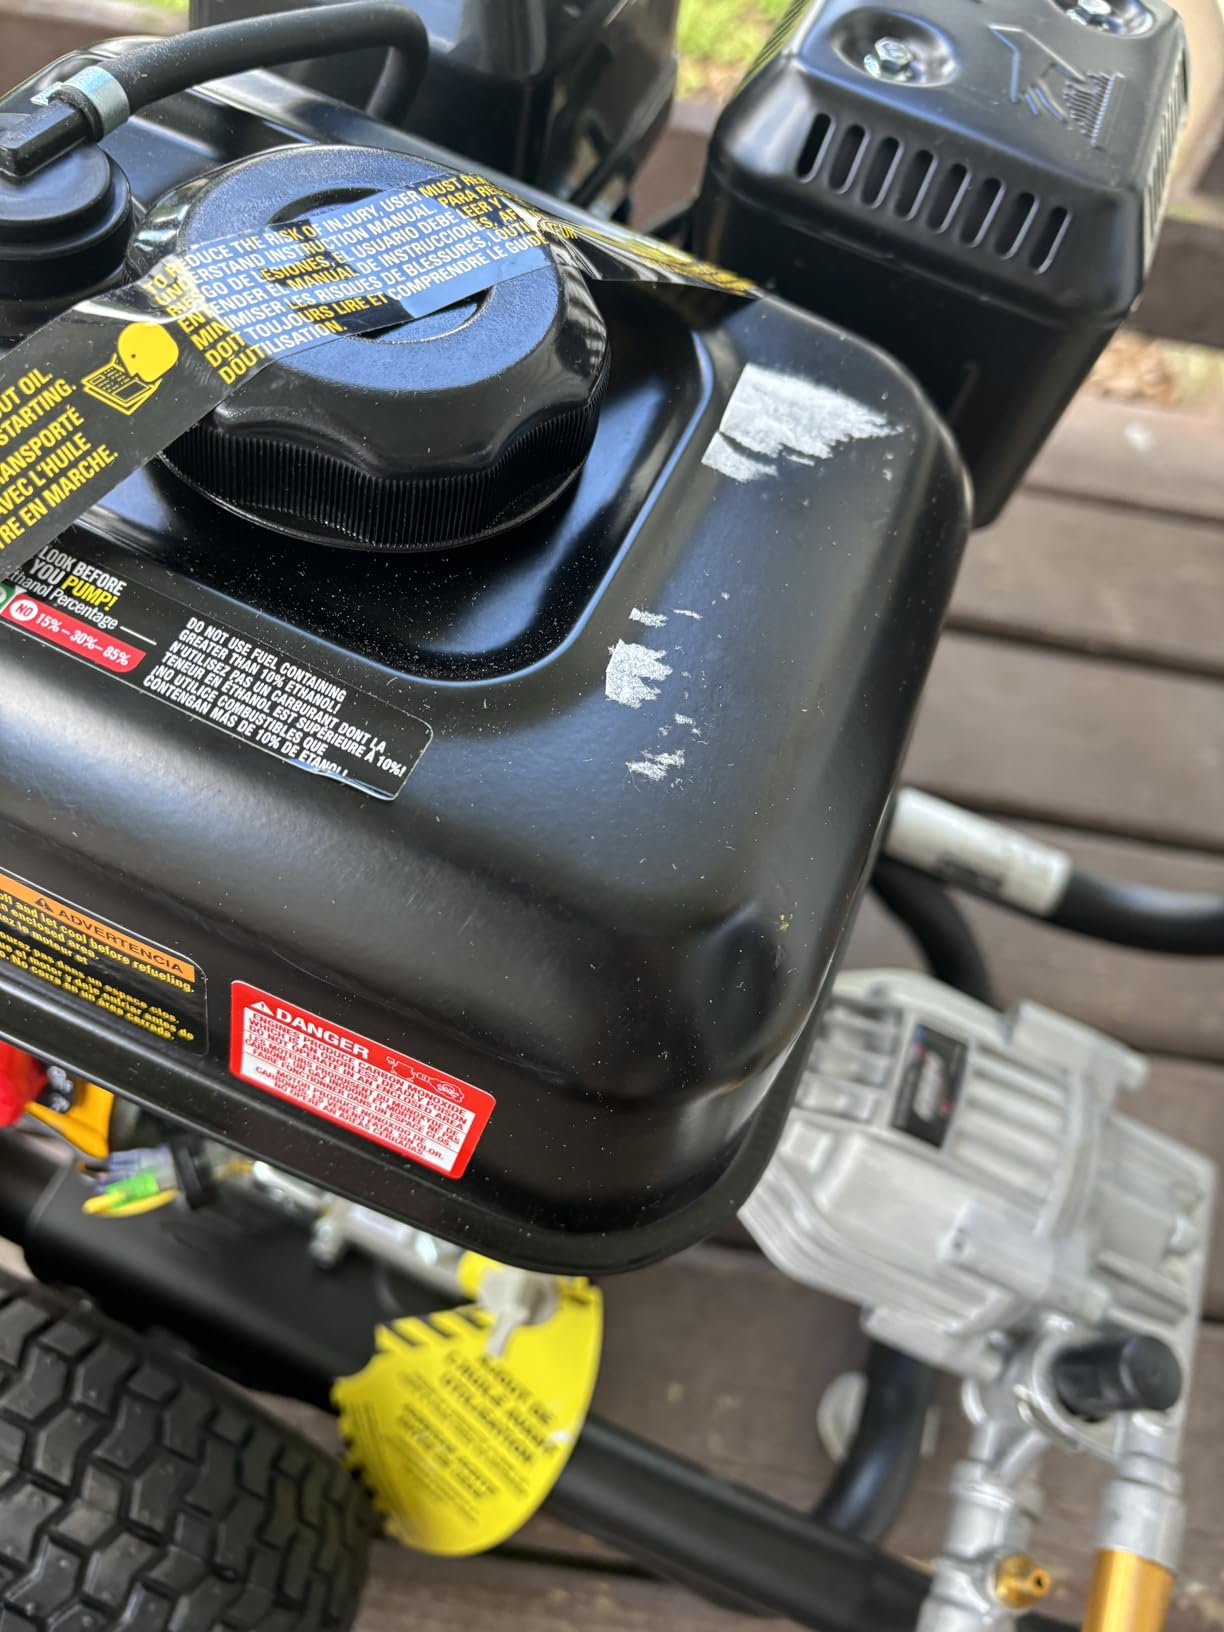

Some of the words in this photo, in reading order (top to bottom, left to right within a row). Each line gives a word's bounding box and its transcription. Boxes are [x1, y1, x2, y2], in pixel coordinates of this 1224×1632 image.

[155, 251, 264, 306] UNDERSTAND
[263, 223, 370, 264] INSTRUCTION
[369, 204, 438, 238] MANUAL.
[438, 190, 478, 210] PARA
[231, 233, 266, 257] THE
[263, 227, 304, 247] RISK
[302, 222, 322, 239] OF
[323, 205, 384, 233] INJURY,
[380, 190, 423, 215] USER
[418, 177, 458, 199] MUST
[231, 272, 255, 291] DE
[253, 255, 336, 285] LESIONES,
[333, 247, 355, 266] EL
[351, 223, 421, 261] USUARIO
[417, 213, 460, 239] DEBE
[458, 199, 493, 221] LEER
[489, 195, 503, 211] Y
[176, 287, 269, 333] ENTENDER
[267, 282, 290, 300] EL
[285, 263, 359, 292] MANUAL
[356, 256, 381, 276] DE
[379, 214, 496, 268] INSTRUCCIONES.
[188, 299, 286, 352] MINIMISER
[286, 291, 316, 311] LES
[314, 275, 382, 305] RISQUES
[380, 266, 407, 288] DE
[404, 234, 492, 277] BLESSURES,
[203, 332, 248, 368] DOIT
[244, 304, 335, 341] TOUJOURS
[332, 296, 371, 316] LIRE
[367, 291, 389, 307] ET
[386, 254, 490, 301] COMPRENDRE
[486, 246, 508, 264] LE
[504, 234, 550, 256] GUIDE
[17, 367, 53, 395] OIL.
[18, 498, 49, 528] EN
[41, 444, 119, 508] MARCHE.
[30, 431, 92, 487] L'HUILE
[10, 568, 52, 596] thanol
[49, 589, 119, 631] Percentage
[29, 559, 64, 586] YOU
[61, 575, 117, 612] PUMP!
[39, 545, 75, 571] LOOK
[73, 561, 126, 595] BEFORE
[15, 603, 33, 618] NO
[36, 613, 61, 632] 15%
[169, 641, 230, 676] N'UTILISEZ
[230, 670, 254, 688] PAS
[253, 681, 271, 696] UN
[270, 690, 338, 729] CARBURANT
[338, 723, 370, 744] DONT
[370, 738, 387, 753] LA
[178, 629, 229, 660] GREATER
[229, 653, 260, 674] THAN
[259, 668, 286, 687] 10%
[285, 681, 341, 714] ETHANOL!
[186, 618, 205, 633] DO
[204, 626, 228, 644] NOT
[227, 637, 252, 656] USE
[250, 648, 281, 669] FUEL
[279, 662, 348, 702] CONTAINING
[143, 675, 211, 714] CONTENGAN
[209, 706, 239, 727] MÁS
[237, 720, 256, 736] DE
[254, 729, 282, 749] 10%
[280, 741, 300, 757] DE
[161, 652, 205, 679] TENEUR
[204, 673, 222, 687] EN
[221, 679, 274, 712] ÉTHANOL
[273, 706, 297, 724] EST
[295, 716, 366, 757] SUPÉRIEURE
[375, 755, 406, 777] 10%!
[173, 674, 218, 702] UTILICE
[216, 695, 304, 743] COMBUSTIBLES
[302, 736, 328, 755] QUE
[10, 908, 64, 942] enclosed
[67, 939, 99, 960] area.
[10, 954, 28, 969] No
[15, 900, 38, 918] and
[40, 913, 58, 928] let
[59, 922, 87, 944] cool
[88, 937, 130, 965] before
[131, 959, 194, 992] refueling.
[30, 930, 72, 957] moteur
[74, 953, 87, 965] et
[59, 907, 183, 974] ADVERTENCIA
[28, 955, 62, 978] motor
[101, 990, 141, 1015] enfriar
[142, 1011, 176, 1032] antes
[177, 1026, 194, 1041] de
[103, 983, 147, 1009] espace
[276, 1007, 369, 1059] DANGER
[249, 1018, 284, 1039] WHICH
[289, 1036, 299, 1045] IS
[303, 1043, 317, 1054] AN
[321, 1051, 377, 1081] ODORLESS
[381, 1079, 424, 1103] DEADLY
[427, 1101, 467, 1123] POISON
[249, 1025, 263, 1036] DO
[268, 1033, 287, 1047] NOT
[292, 1045, 339, 1071] OPERATE
[343, 1069, 354, 1077] IN
[357, 1075, 372, 1086] AN
[376, 1084, 432, 1113] ENCLOSED
[435, 1112, 464, 1129] AREA
[254, 1013, 299, 1039] ENGINES
[303, 1036, 354, 1064] PRODUCE
[358, 1062, 403, 1086] CARBON
[407, 1084, 466, 1115] MONOXIDE
[254, 1049, 279, 1065] FAIRE
[282, 1062, 344, 1095] FONCTIONNER
[348, 1093, 371, 1107] DANS
[375, 1105, 386, 1114] UN
[391, 1113, 424, 1132] ESPACE
[269, 1043, 312, 1067] MOTEURS
[316, 1065, 372, 1095] PRODUISENT
[377, 1094, 388, 1102] DU
[392, 1101, 444, 1128] MONOXYDE
[447, 1127, 458, 1136] DE
[278, 1070, 310, 1089] MOTOR
[314, 1087, 358, 1111] PRODUCE
[293, 1060, 305, 1070] UN
[309, 1068, 326, 1080] GAZ
[443, 1132, 460, 1144] PAS
